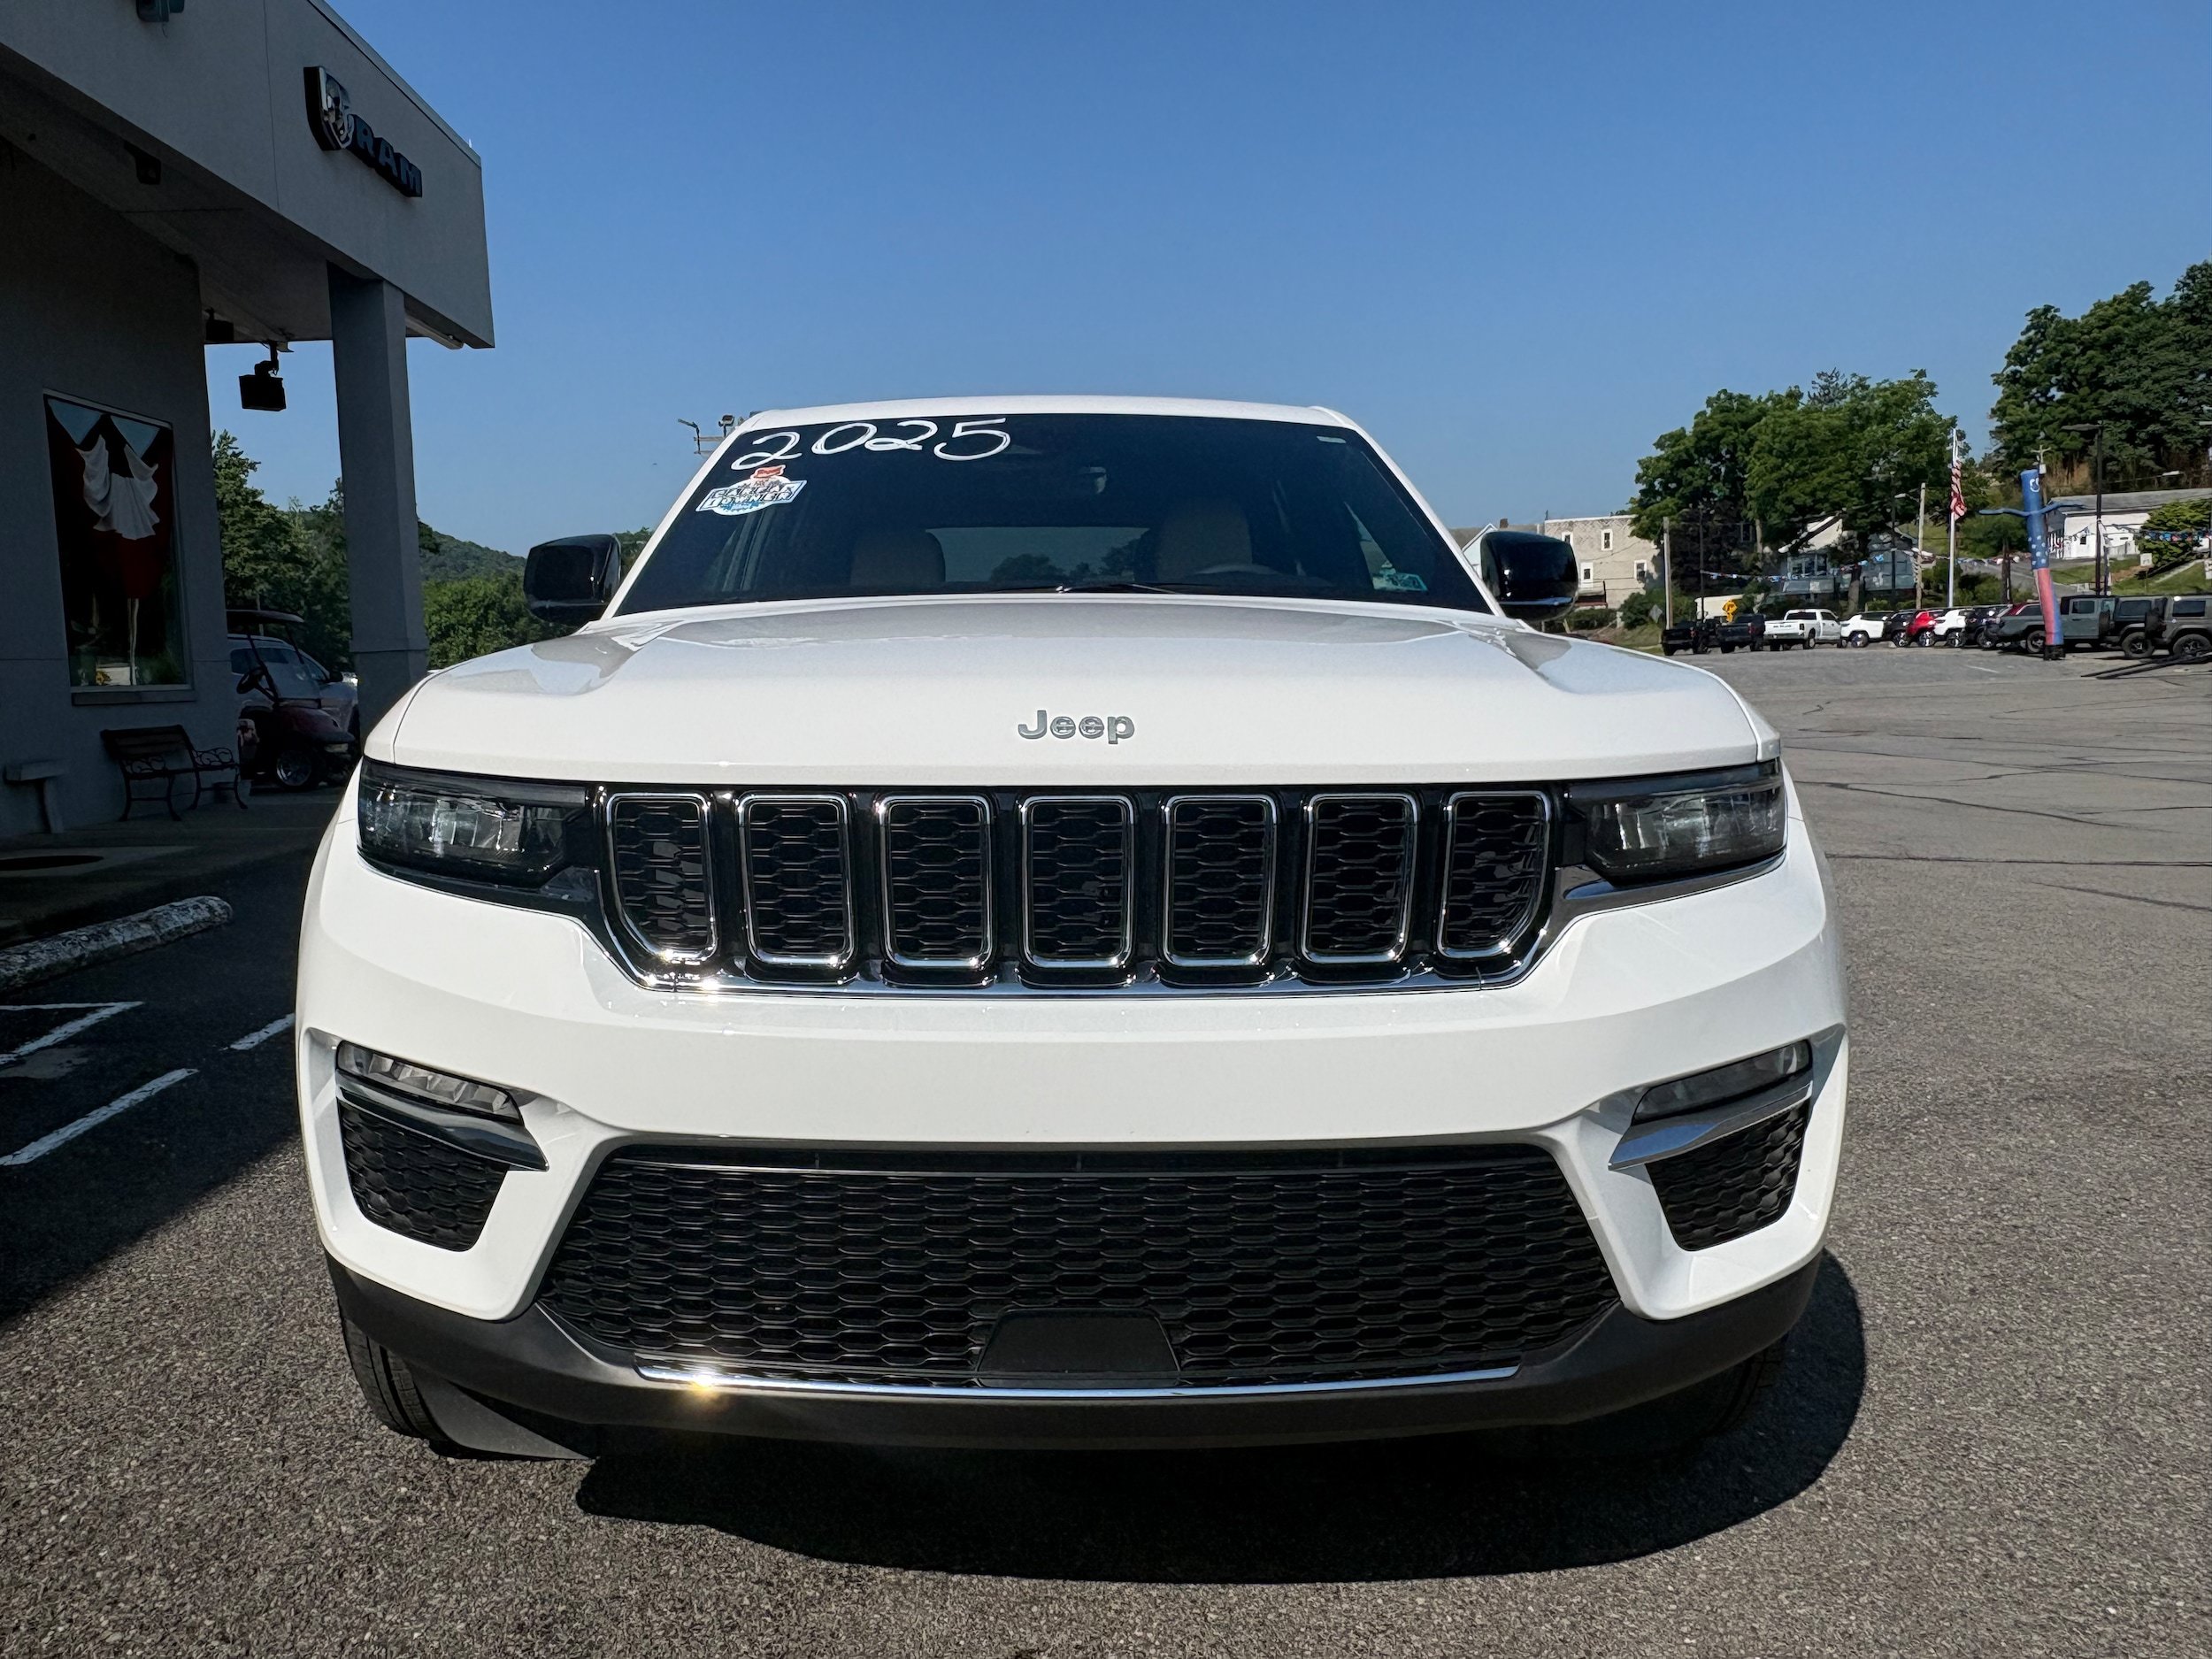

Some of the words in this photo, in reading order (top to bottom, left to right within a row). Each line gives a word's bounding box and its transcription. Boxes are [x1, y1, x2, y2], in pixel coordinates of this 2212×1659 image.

[353, 113, 423, 196] RAM
[731, 417, 1011, 470] 2025
[1018, 710, 1135, 744] Jeep
